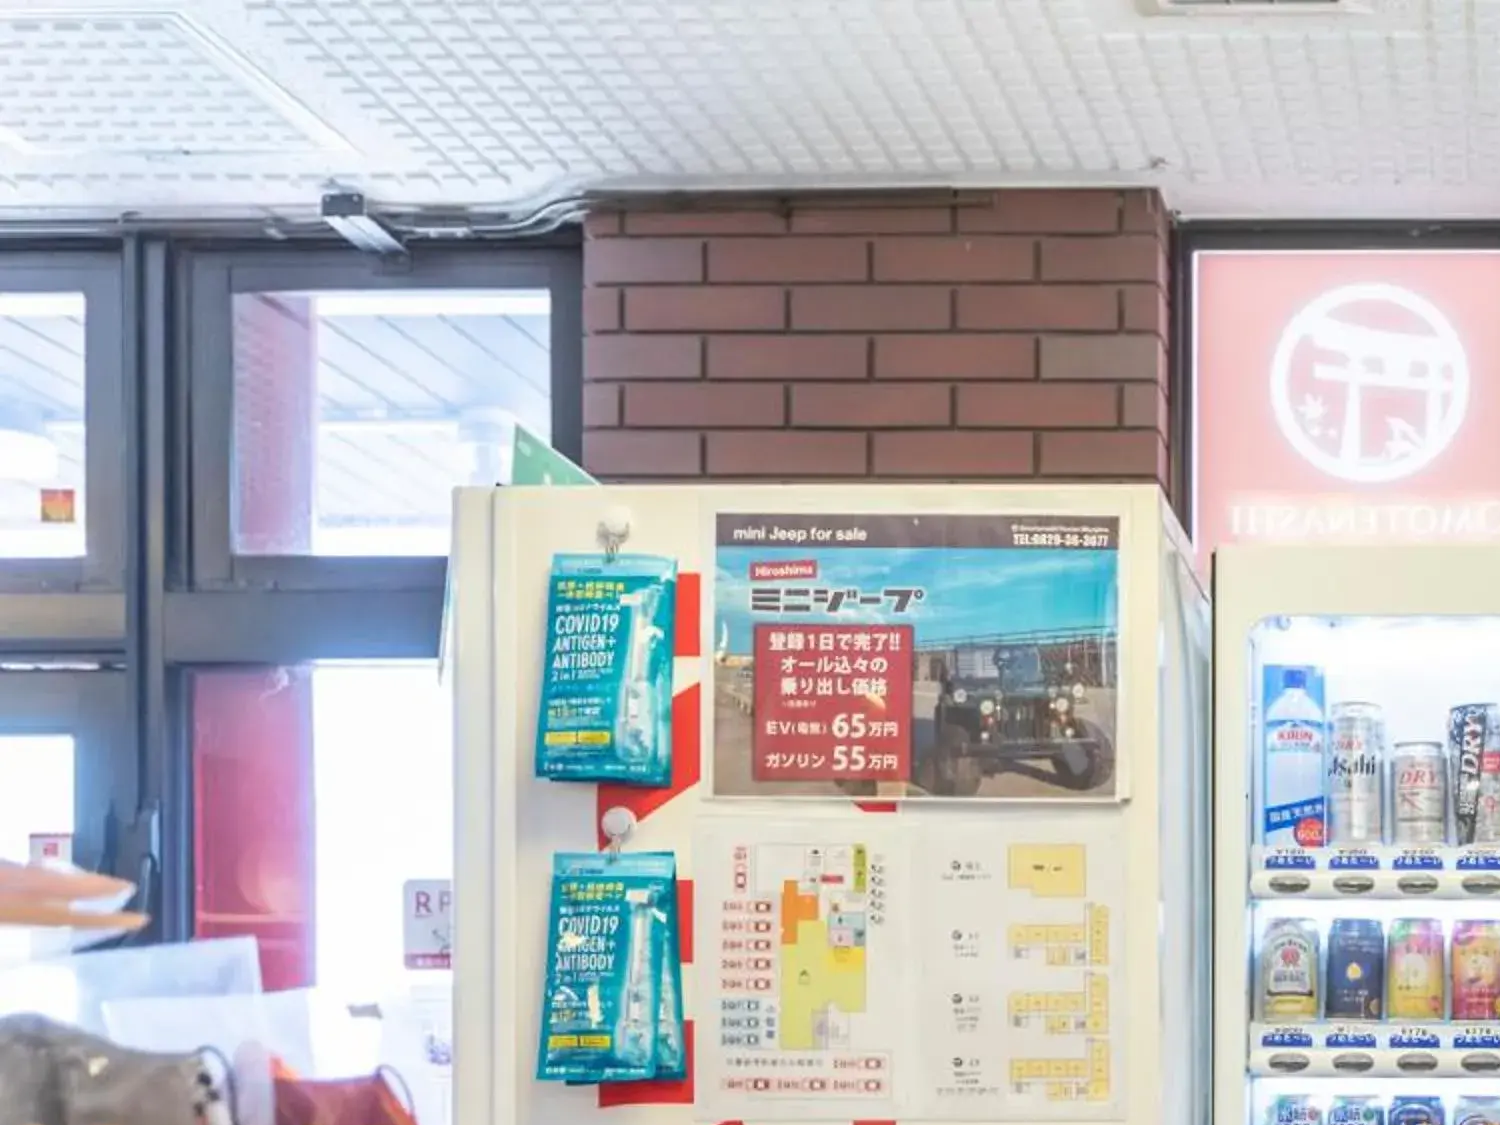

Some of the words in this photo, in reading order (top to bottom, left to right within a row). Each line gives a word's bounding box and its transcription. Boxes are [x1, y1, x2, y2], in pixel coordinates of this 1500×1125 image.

[734, 526, 765, 541] mini
[769, 526, 808, 543] Jeep
[811, 526, 832, 541] for
[835, 527, 868, 542] sale
[755, 564, 814, 577] Hiroshima
[751, 588, 924, 613] ミニジープ
[554, 614, 620, 636] COVID19
[551, 652, 615, 669] ANTIBODY
[765, 752, 826, 769] ガソリン
[1399, 769, 1441, 785] DRY
[558, 914, 620, 936] COVID19
